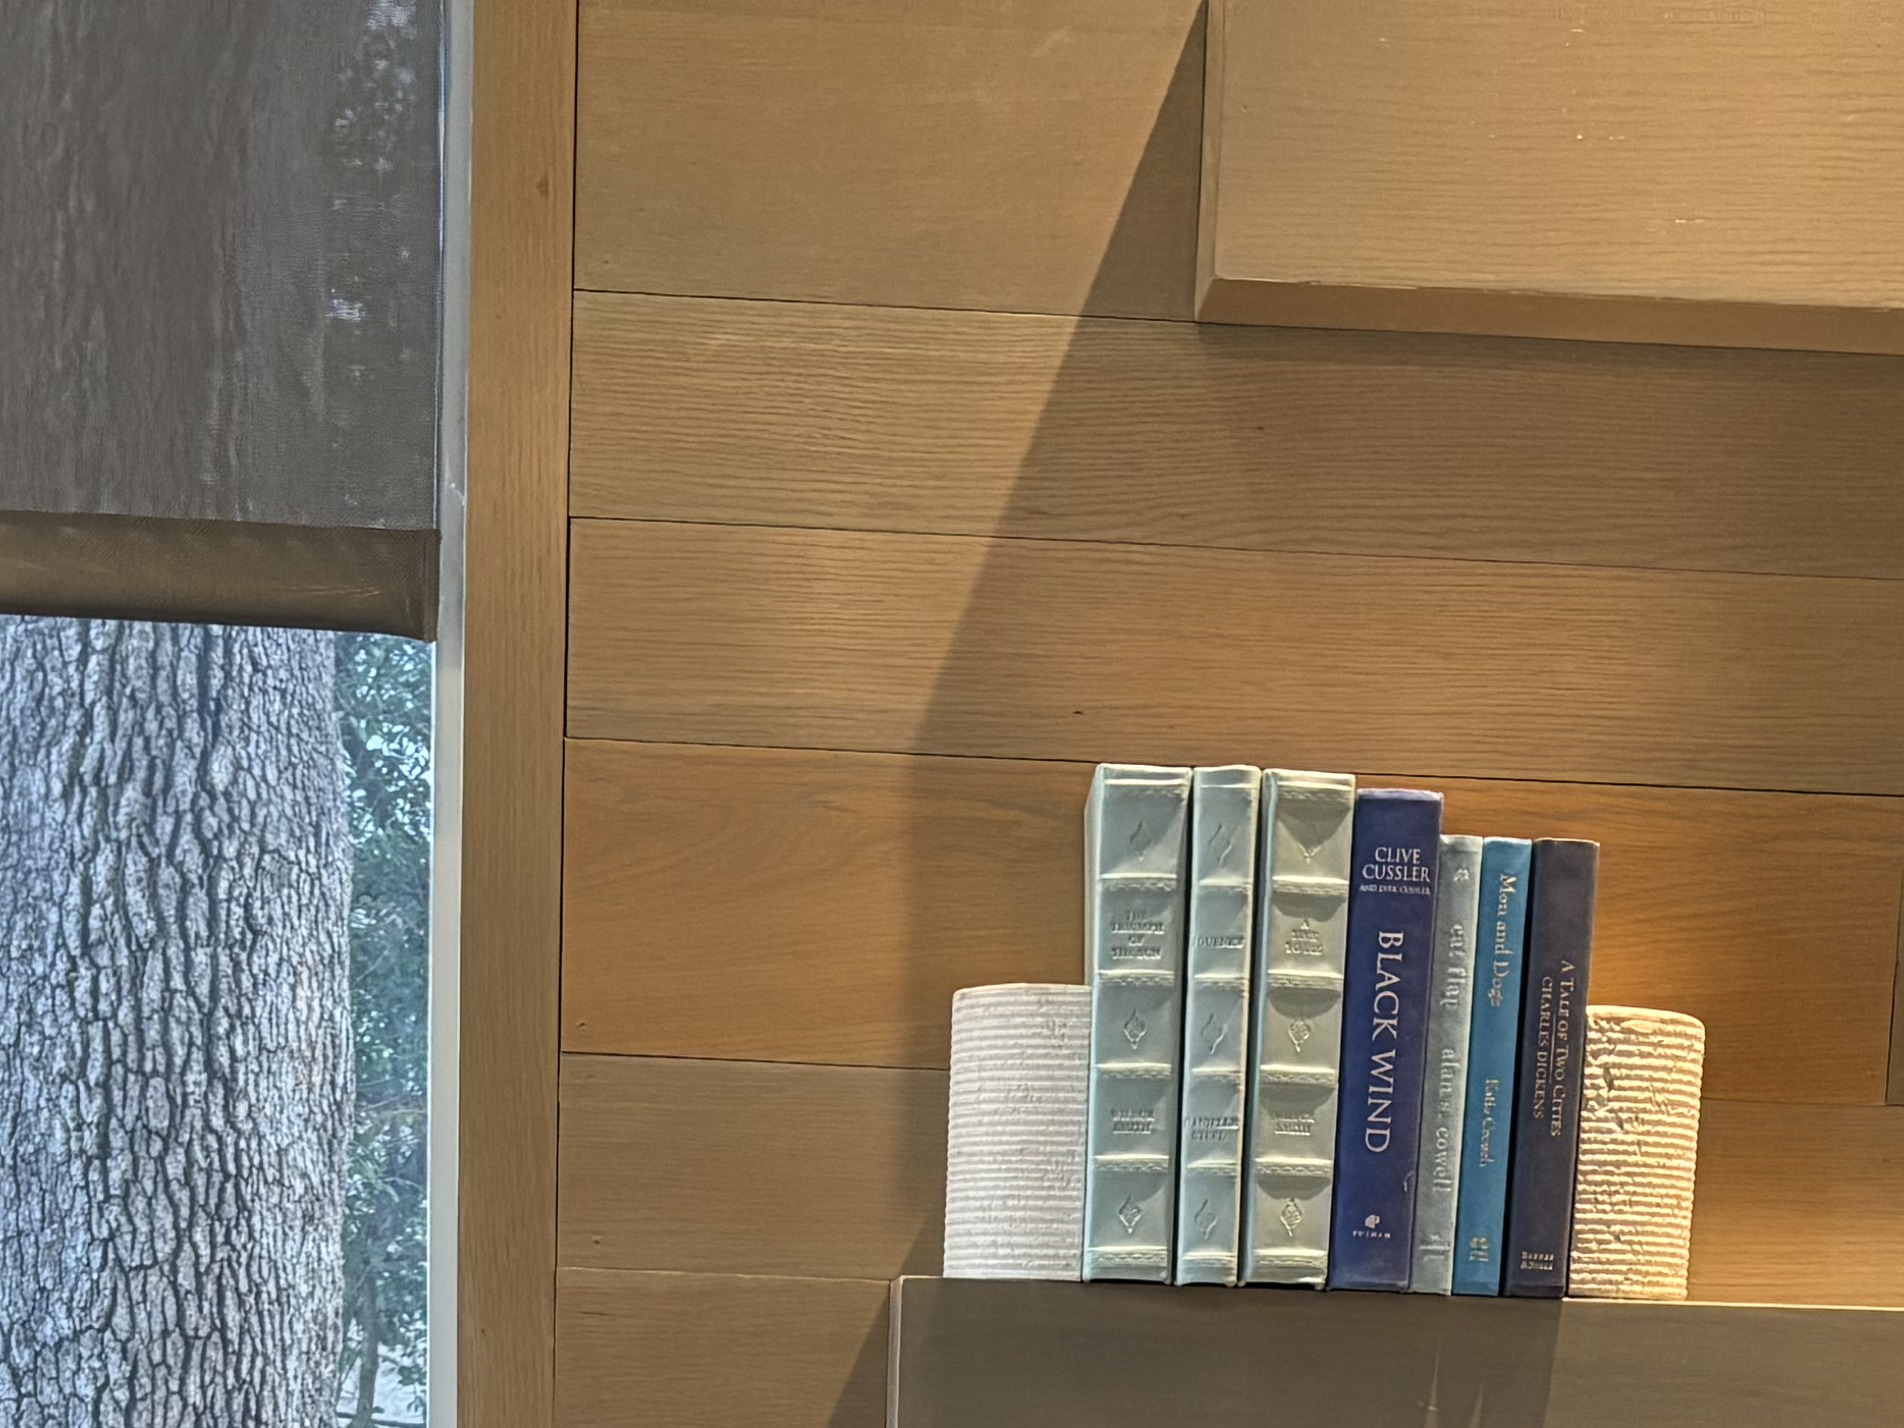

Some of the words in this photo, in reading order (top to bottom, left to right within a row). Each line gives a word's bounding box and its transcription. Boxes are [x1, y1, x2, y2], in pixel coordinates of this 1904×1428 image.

[1361, 864, 1430, 882] CUSSLER
[1374, 846, 1421, 864] CLIVE
[1494, 920, 1515, 956] and
[1371, 930, 1405, 1043] BLACK
[1561, 959, 1577, 974] A
[1537, 976, 1554, 1048] CHARLES
[1558, 977, 1575, 1021] TALE
[1557, 1022, 1570, 1042] OF
[1554, 1046, 1570, 1082] TWO
[1365, 1048, 1398, 1153] WIND
[1532, 1051, 1549, 1119] DICKENS
[1549, 1084, 1567, 1137] CITIES
